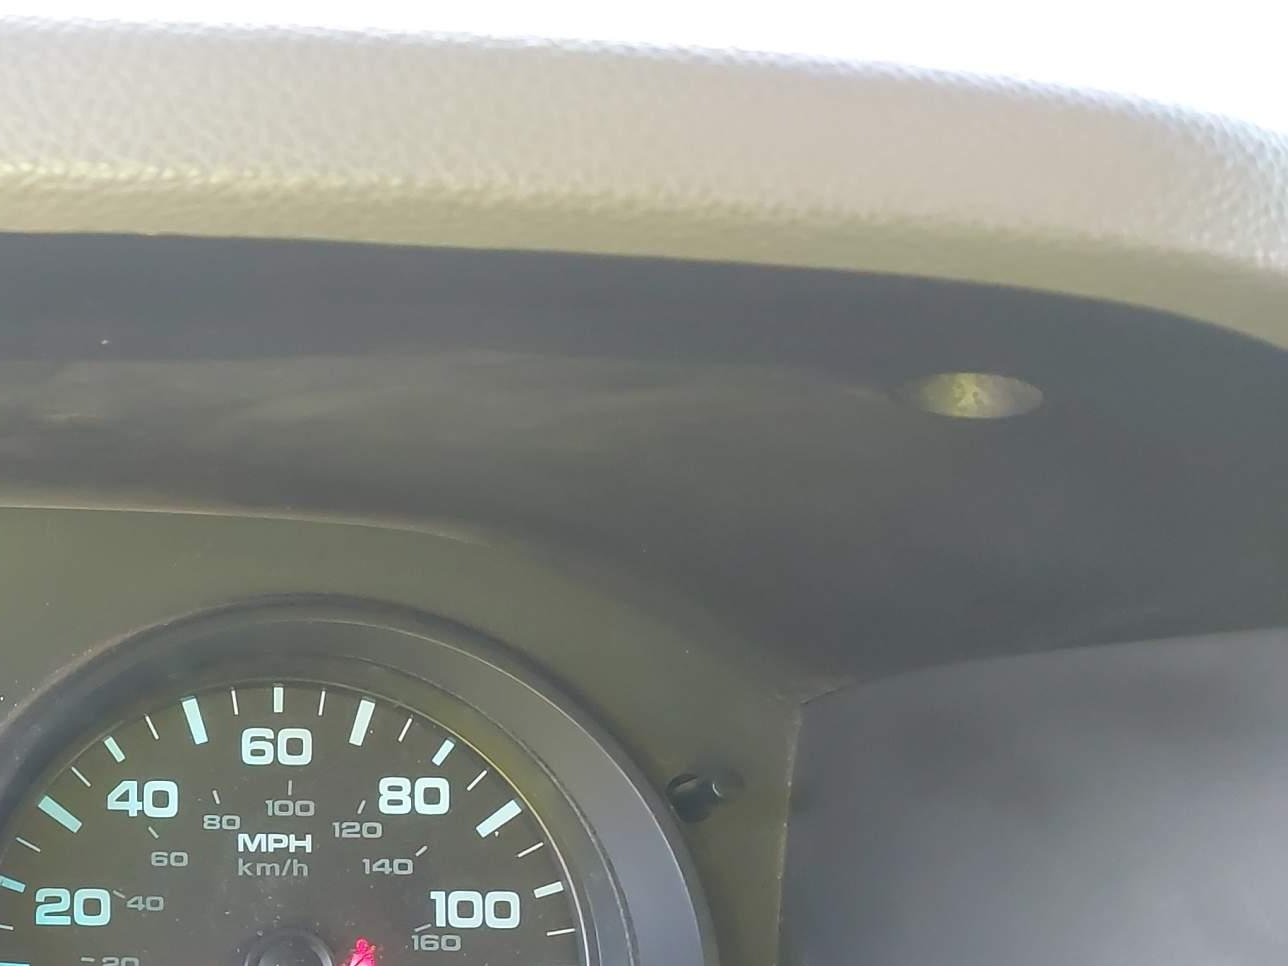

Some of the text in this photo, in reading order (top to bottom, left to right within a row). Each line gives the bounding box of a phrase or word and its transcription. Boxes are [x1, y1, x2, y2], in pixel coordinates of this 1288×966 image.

[241, 728, 313, 766] 60
[107, 780, 179, 818] 40
[378, 776, 450, 815] 80
[265, 800, 315, 817] 100
[203, 815, 240, 831] 80
[332, 822, 383, 839] 120
[237, 833, 312, 853] MPH
[151, 851, 188, 868] 60
[237, 858, 309, 878] km/h
[362, 858, 414, 875] 140
[35, 888, 111, 926] 20
[127, 895, 164, 912] 40
[430, 890, 520, 929] 100
[411, 934, 461, 952] 160
